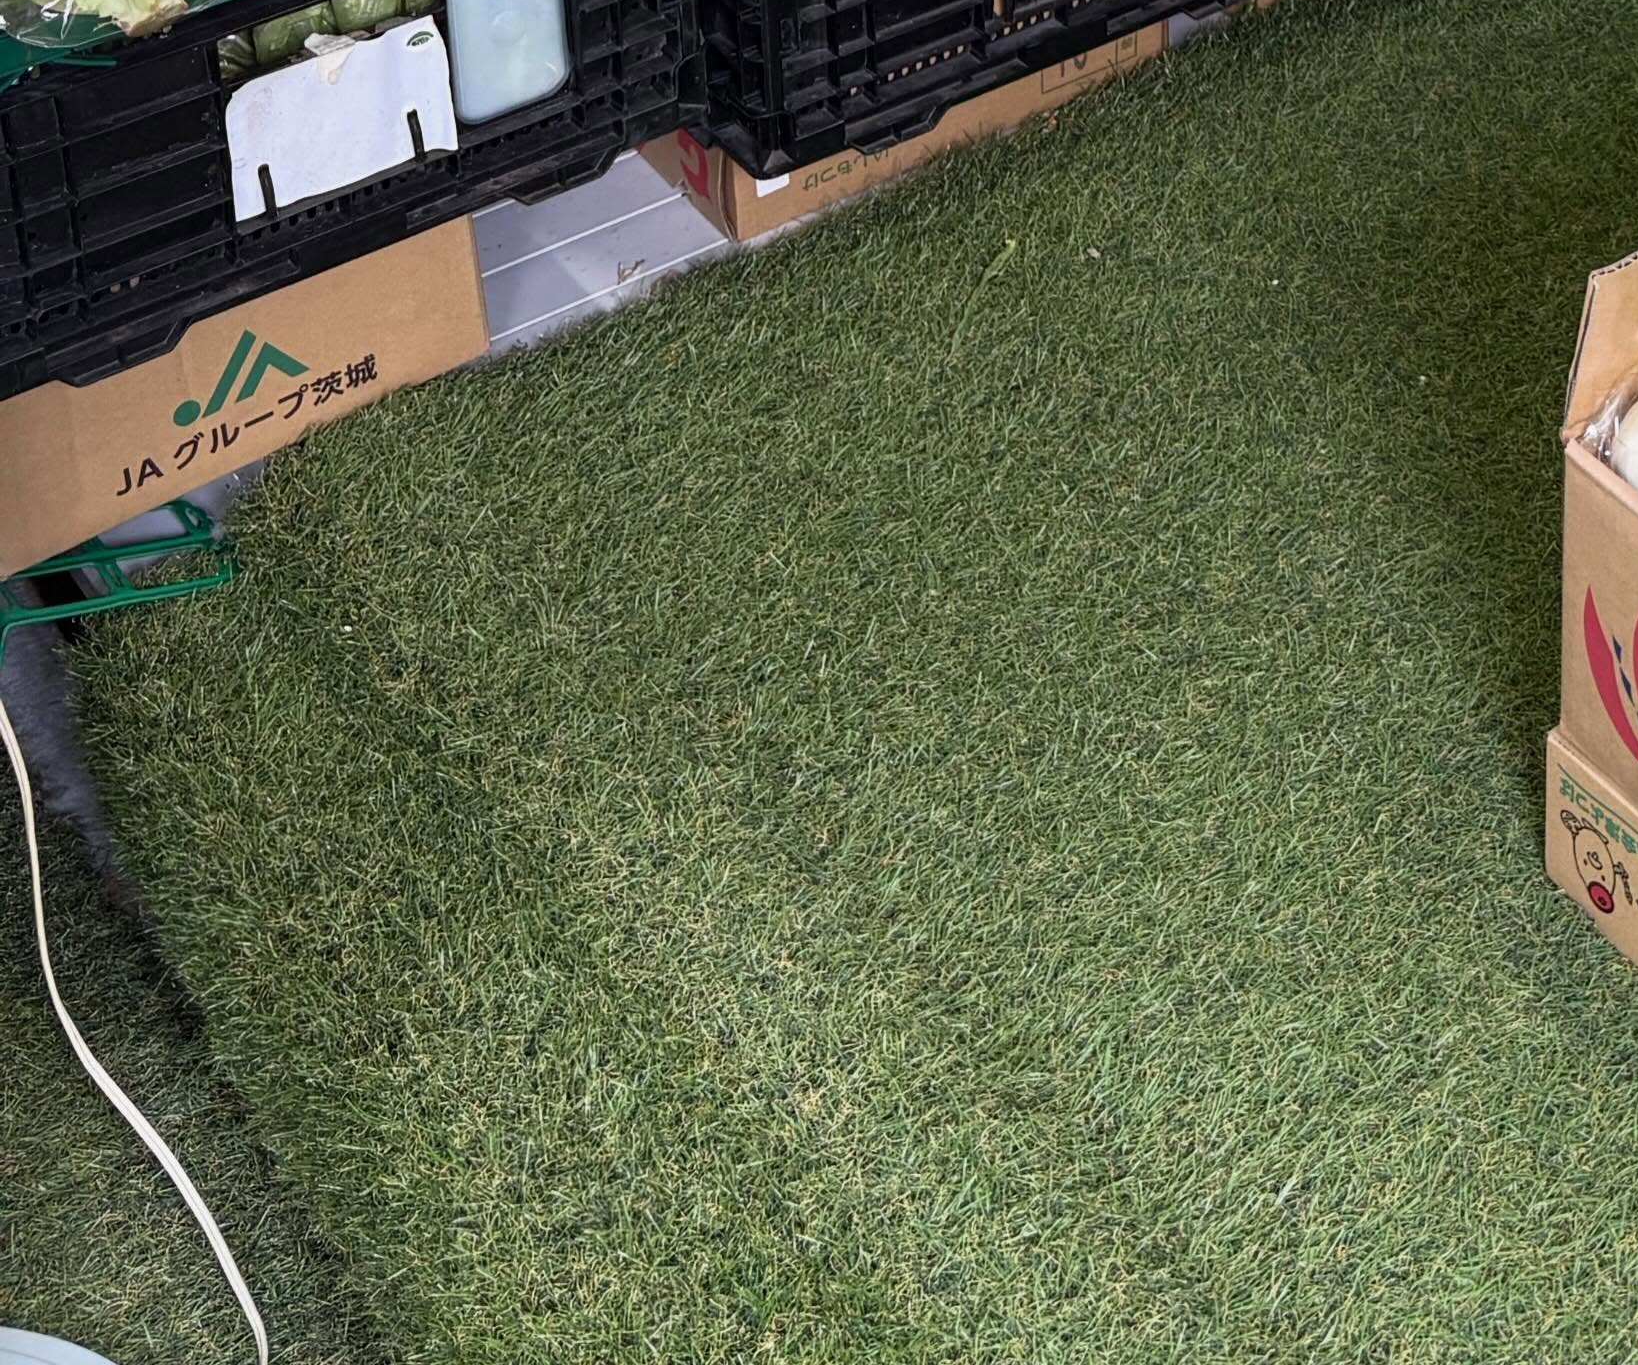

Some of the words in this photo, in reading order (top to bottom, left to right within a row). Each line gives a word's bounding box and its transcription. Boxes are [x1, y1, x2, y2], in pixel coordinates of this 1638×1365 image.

[172, 352, 379, 472] グループ茨城
